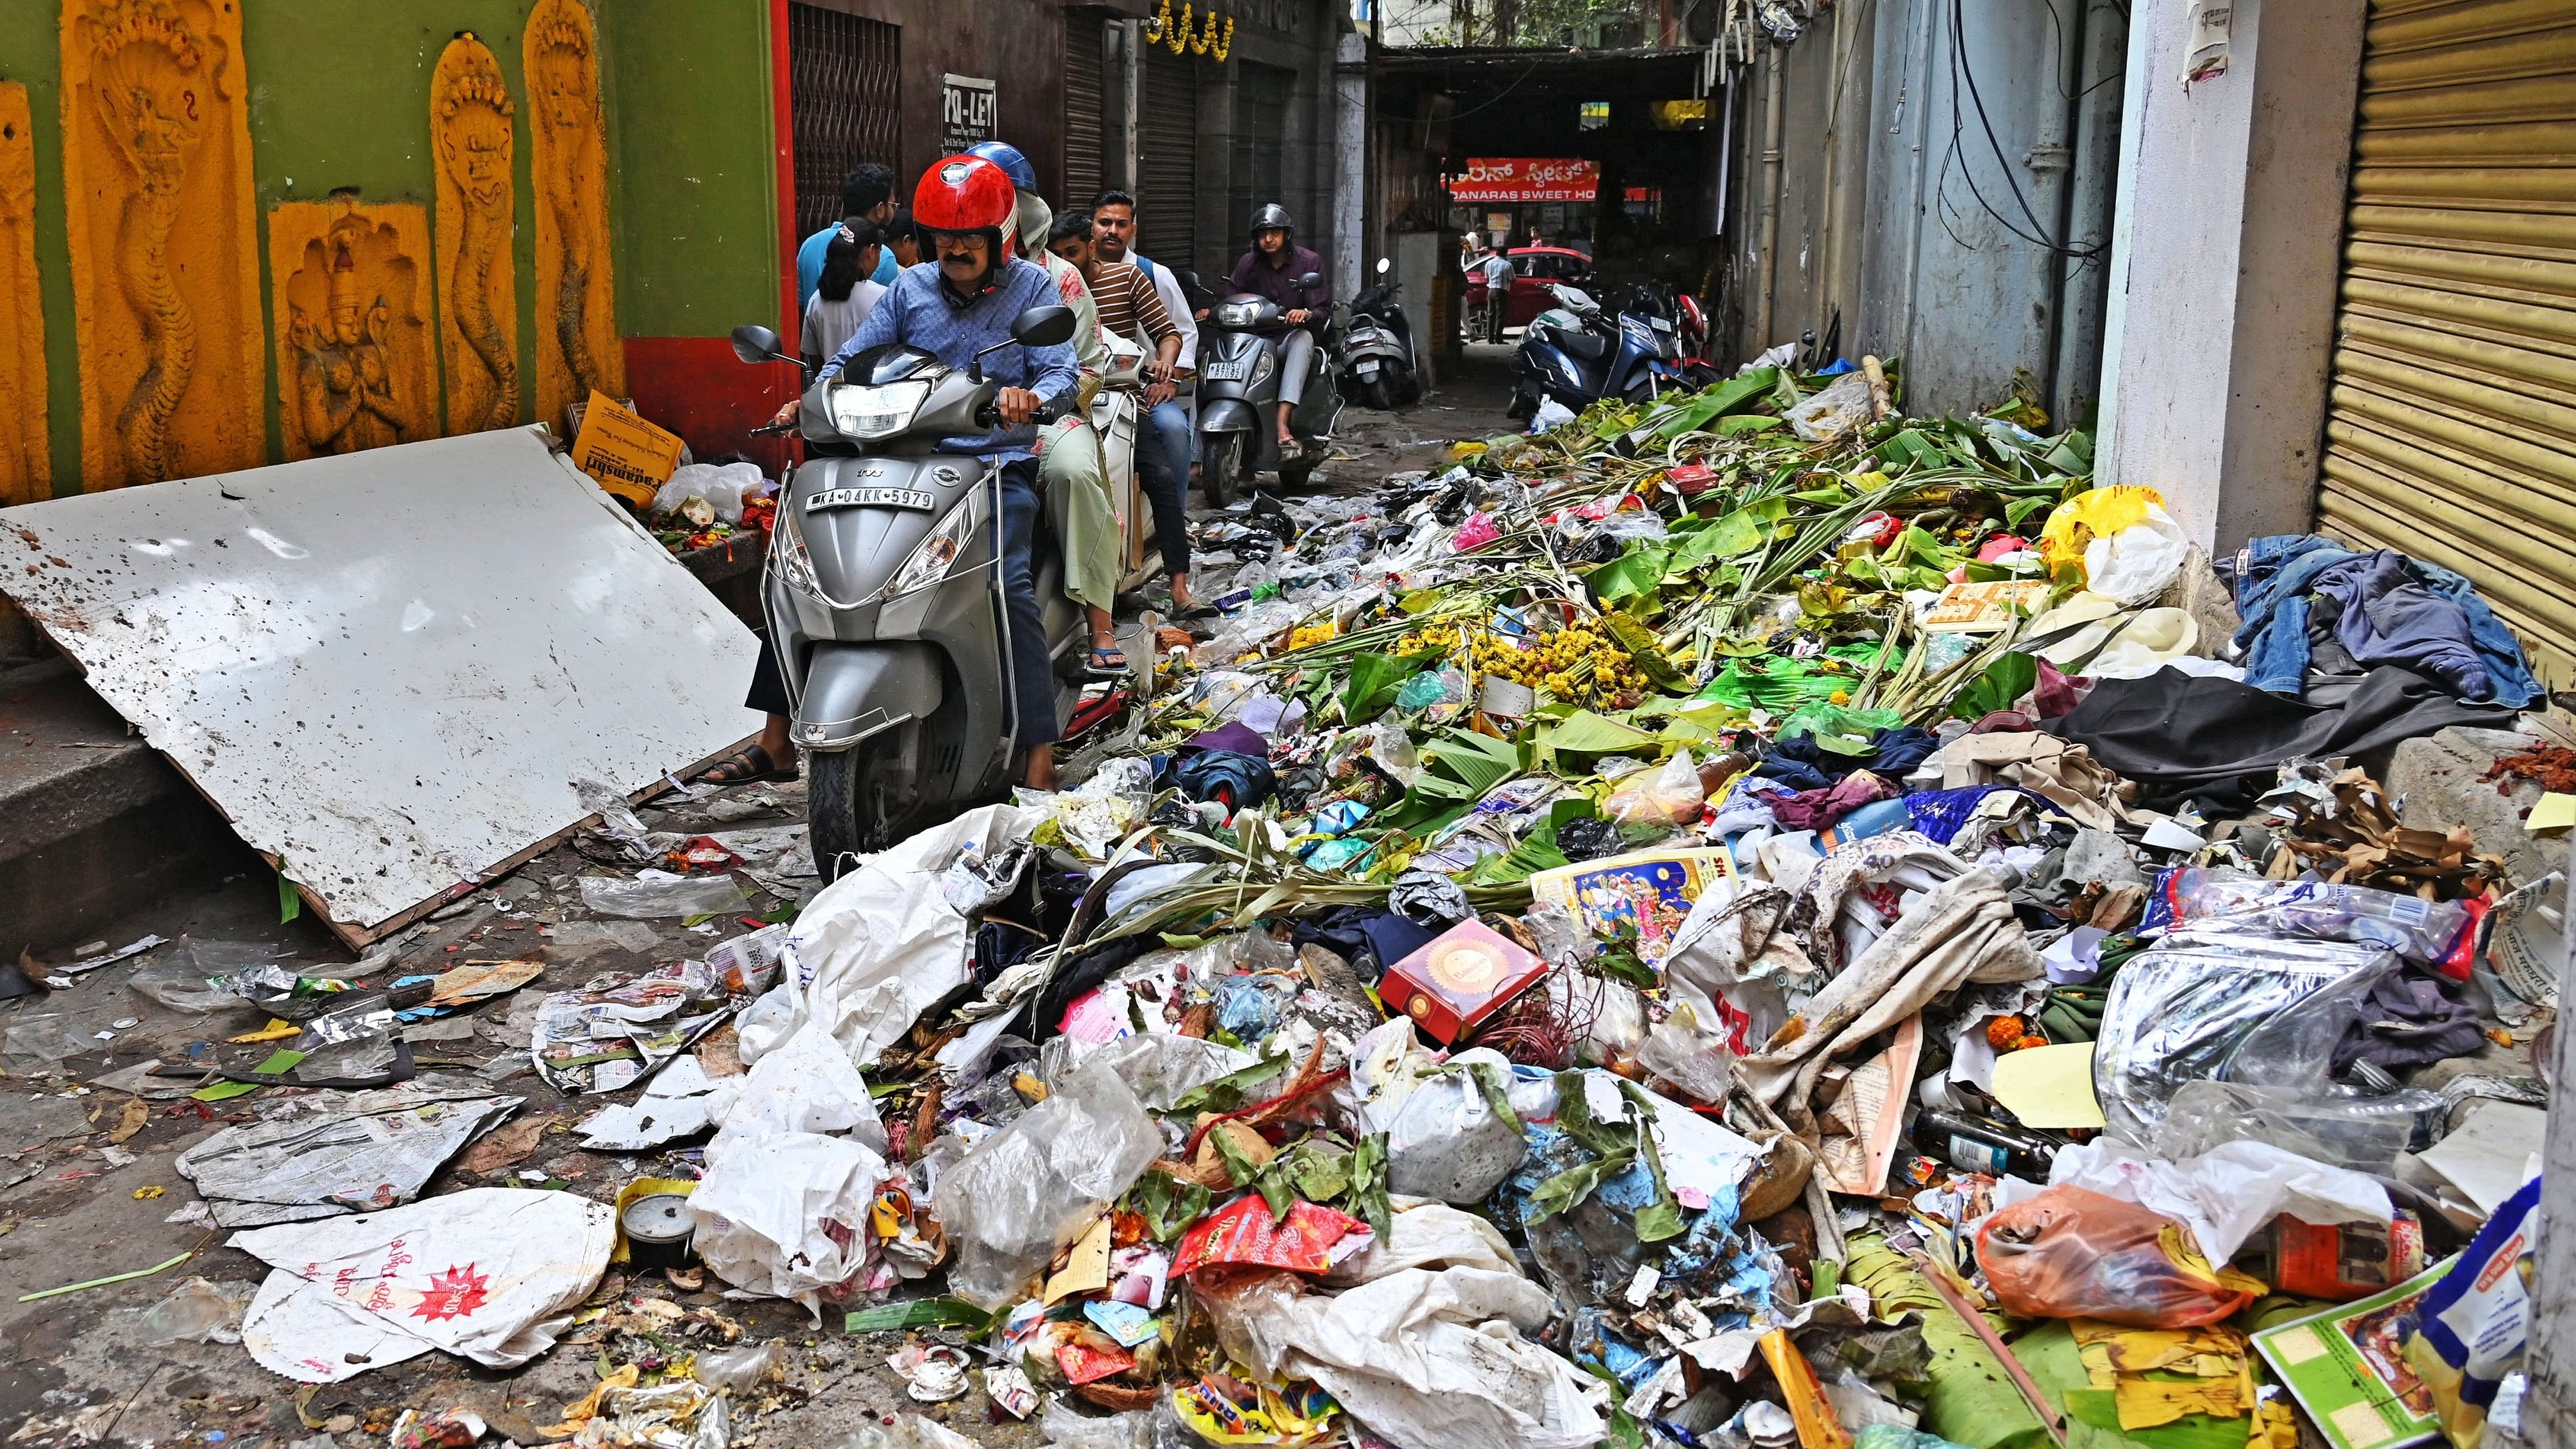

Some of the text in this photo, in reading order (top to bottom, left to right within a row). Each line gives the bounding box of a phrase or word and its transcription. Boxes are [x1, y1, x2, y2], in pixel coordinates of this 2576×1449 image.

[943, 88, 993, 126] TO-LET
[1522, 190, 1571, 199] SWEET
[613, 434, 623, 444] For
[584, 456, 664, 492] Padamshri
[857, 467, 883, 477] TVS
